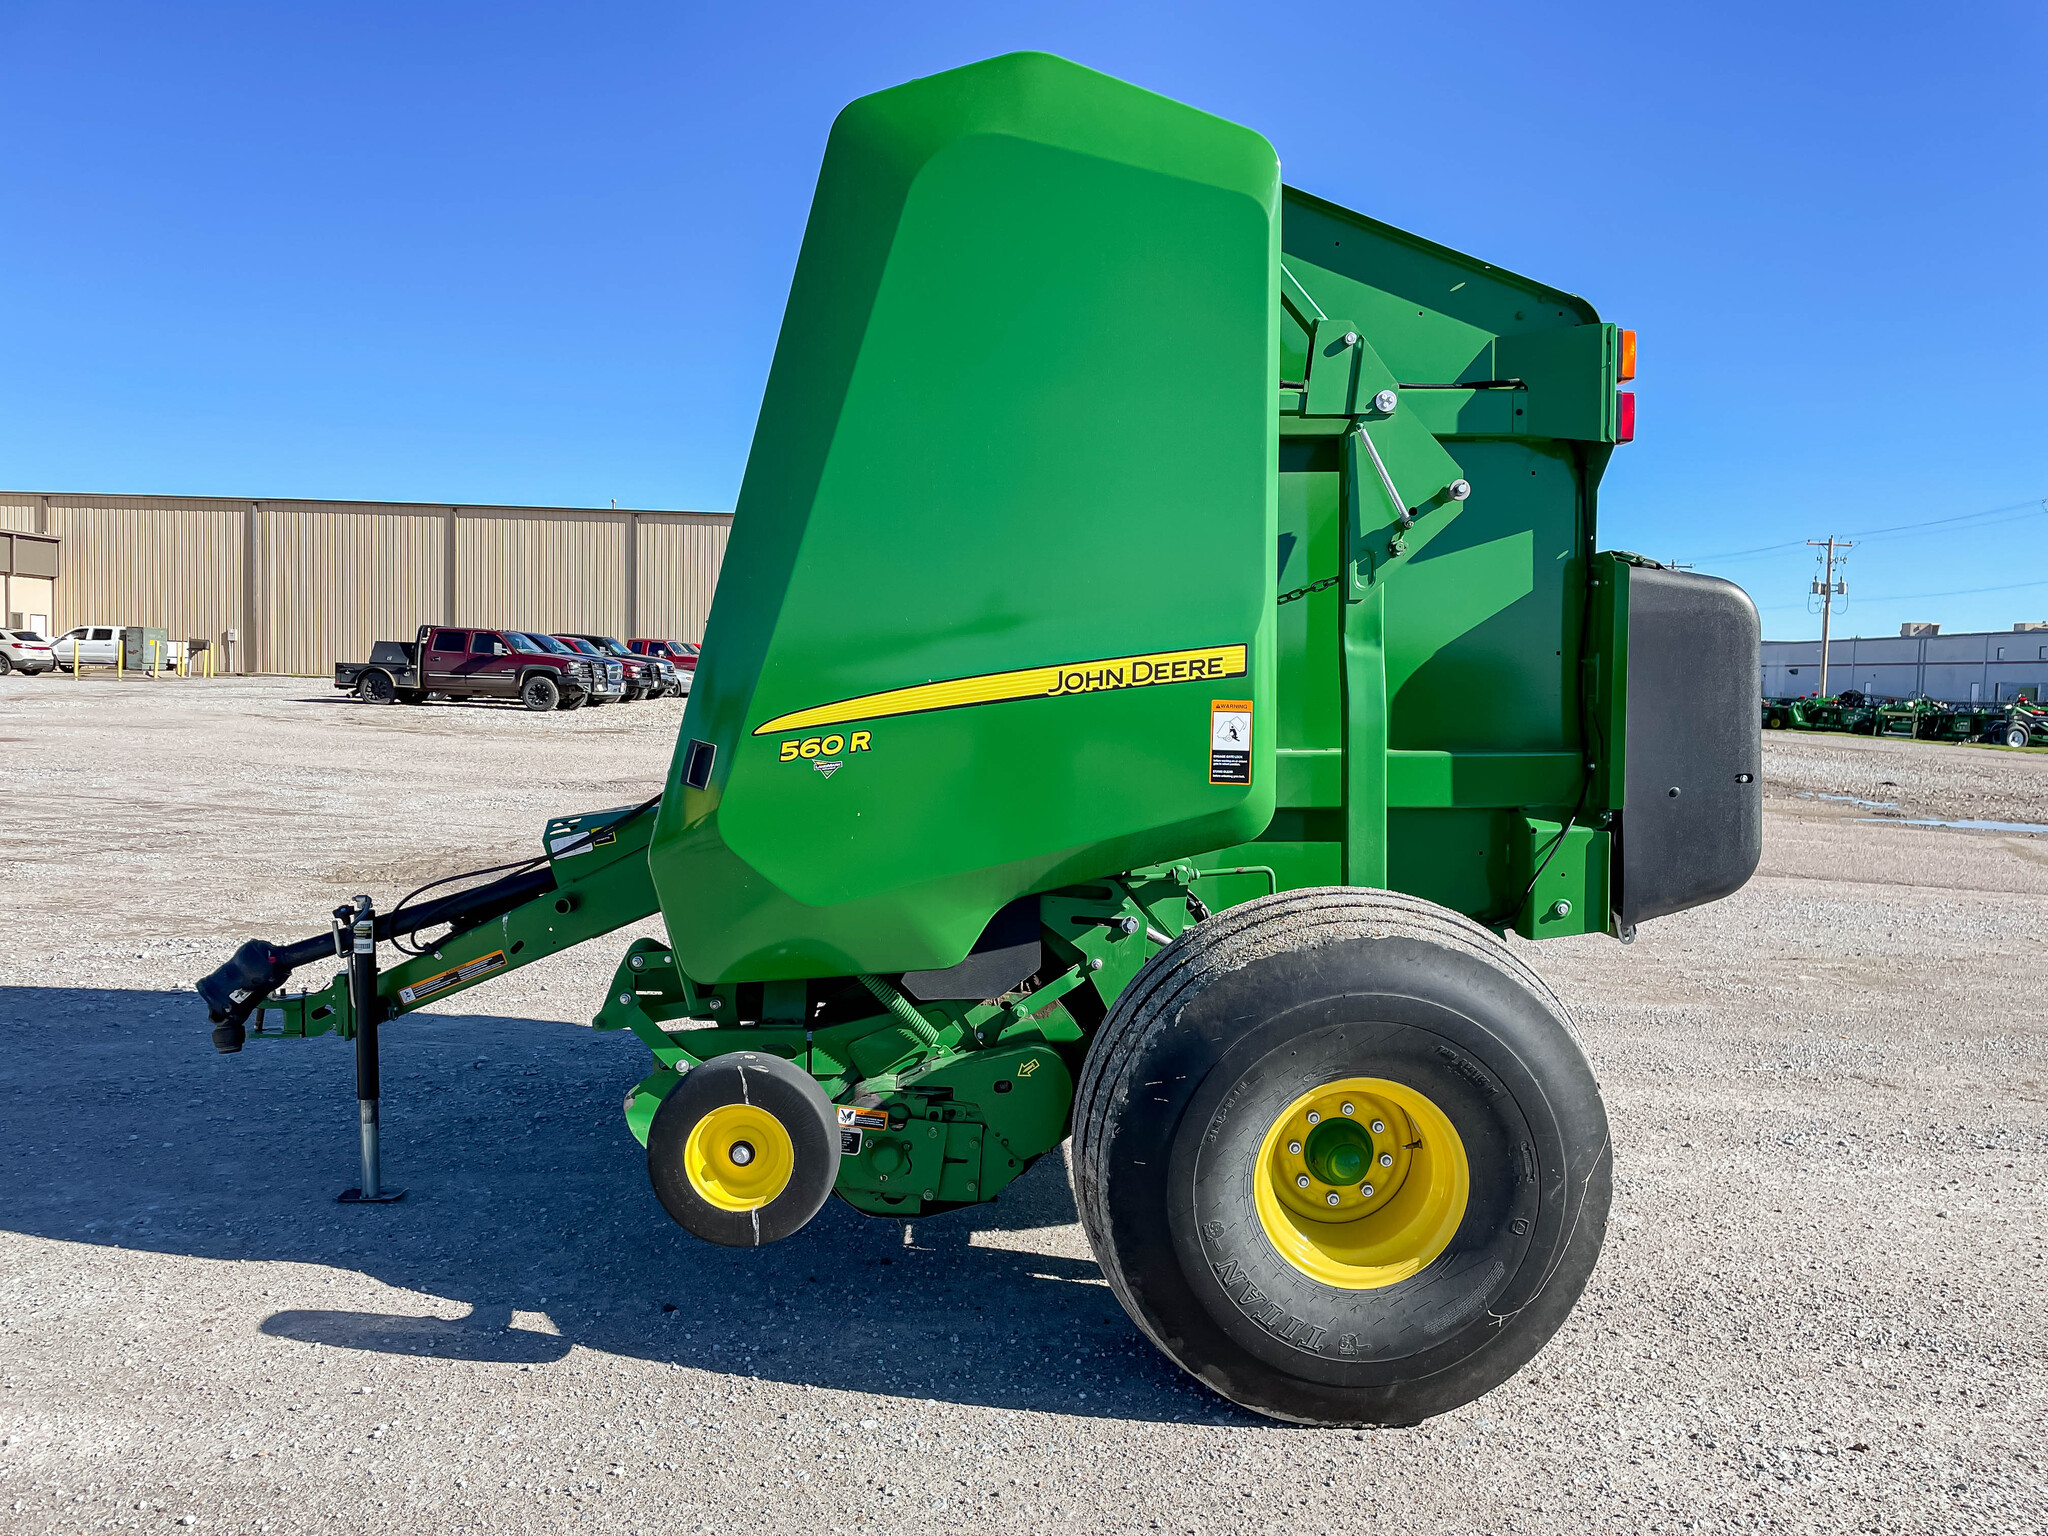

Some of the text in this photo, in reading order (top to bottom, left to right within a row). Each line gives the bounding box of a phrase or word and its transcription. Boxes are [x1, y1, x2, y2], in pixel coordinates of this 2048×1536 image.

[1048, 657, 1223, 693] JOHN DEERE
[779, 730, 872, 762] 560 R
[1213, 1260, 1327, 1354] TITAN
